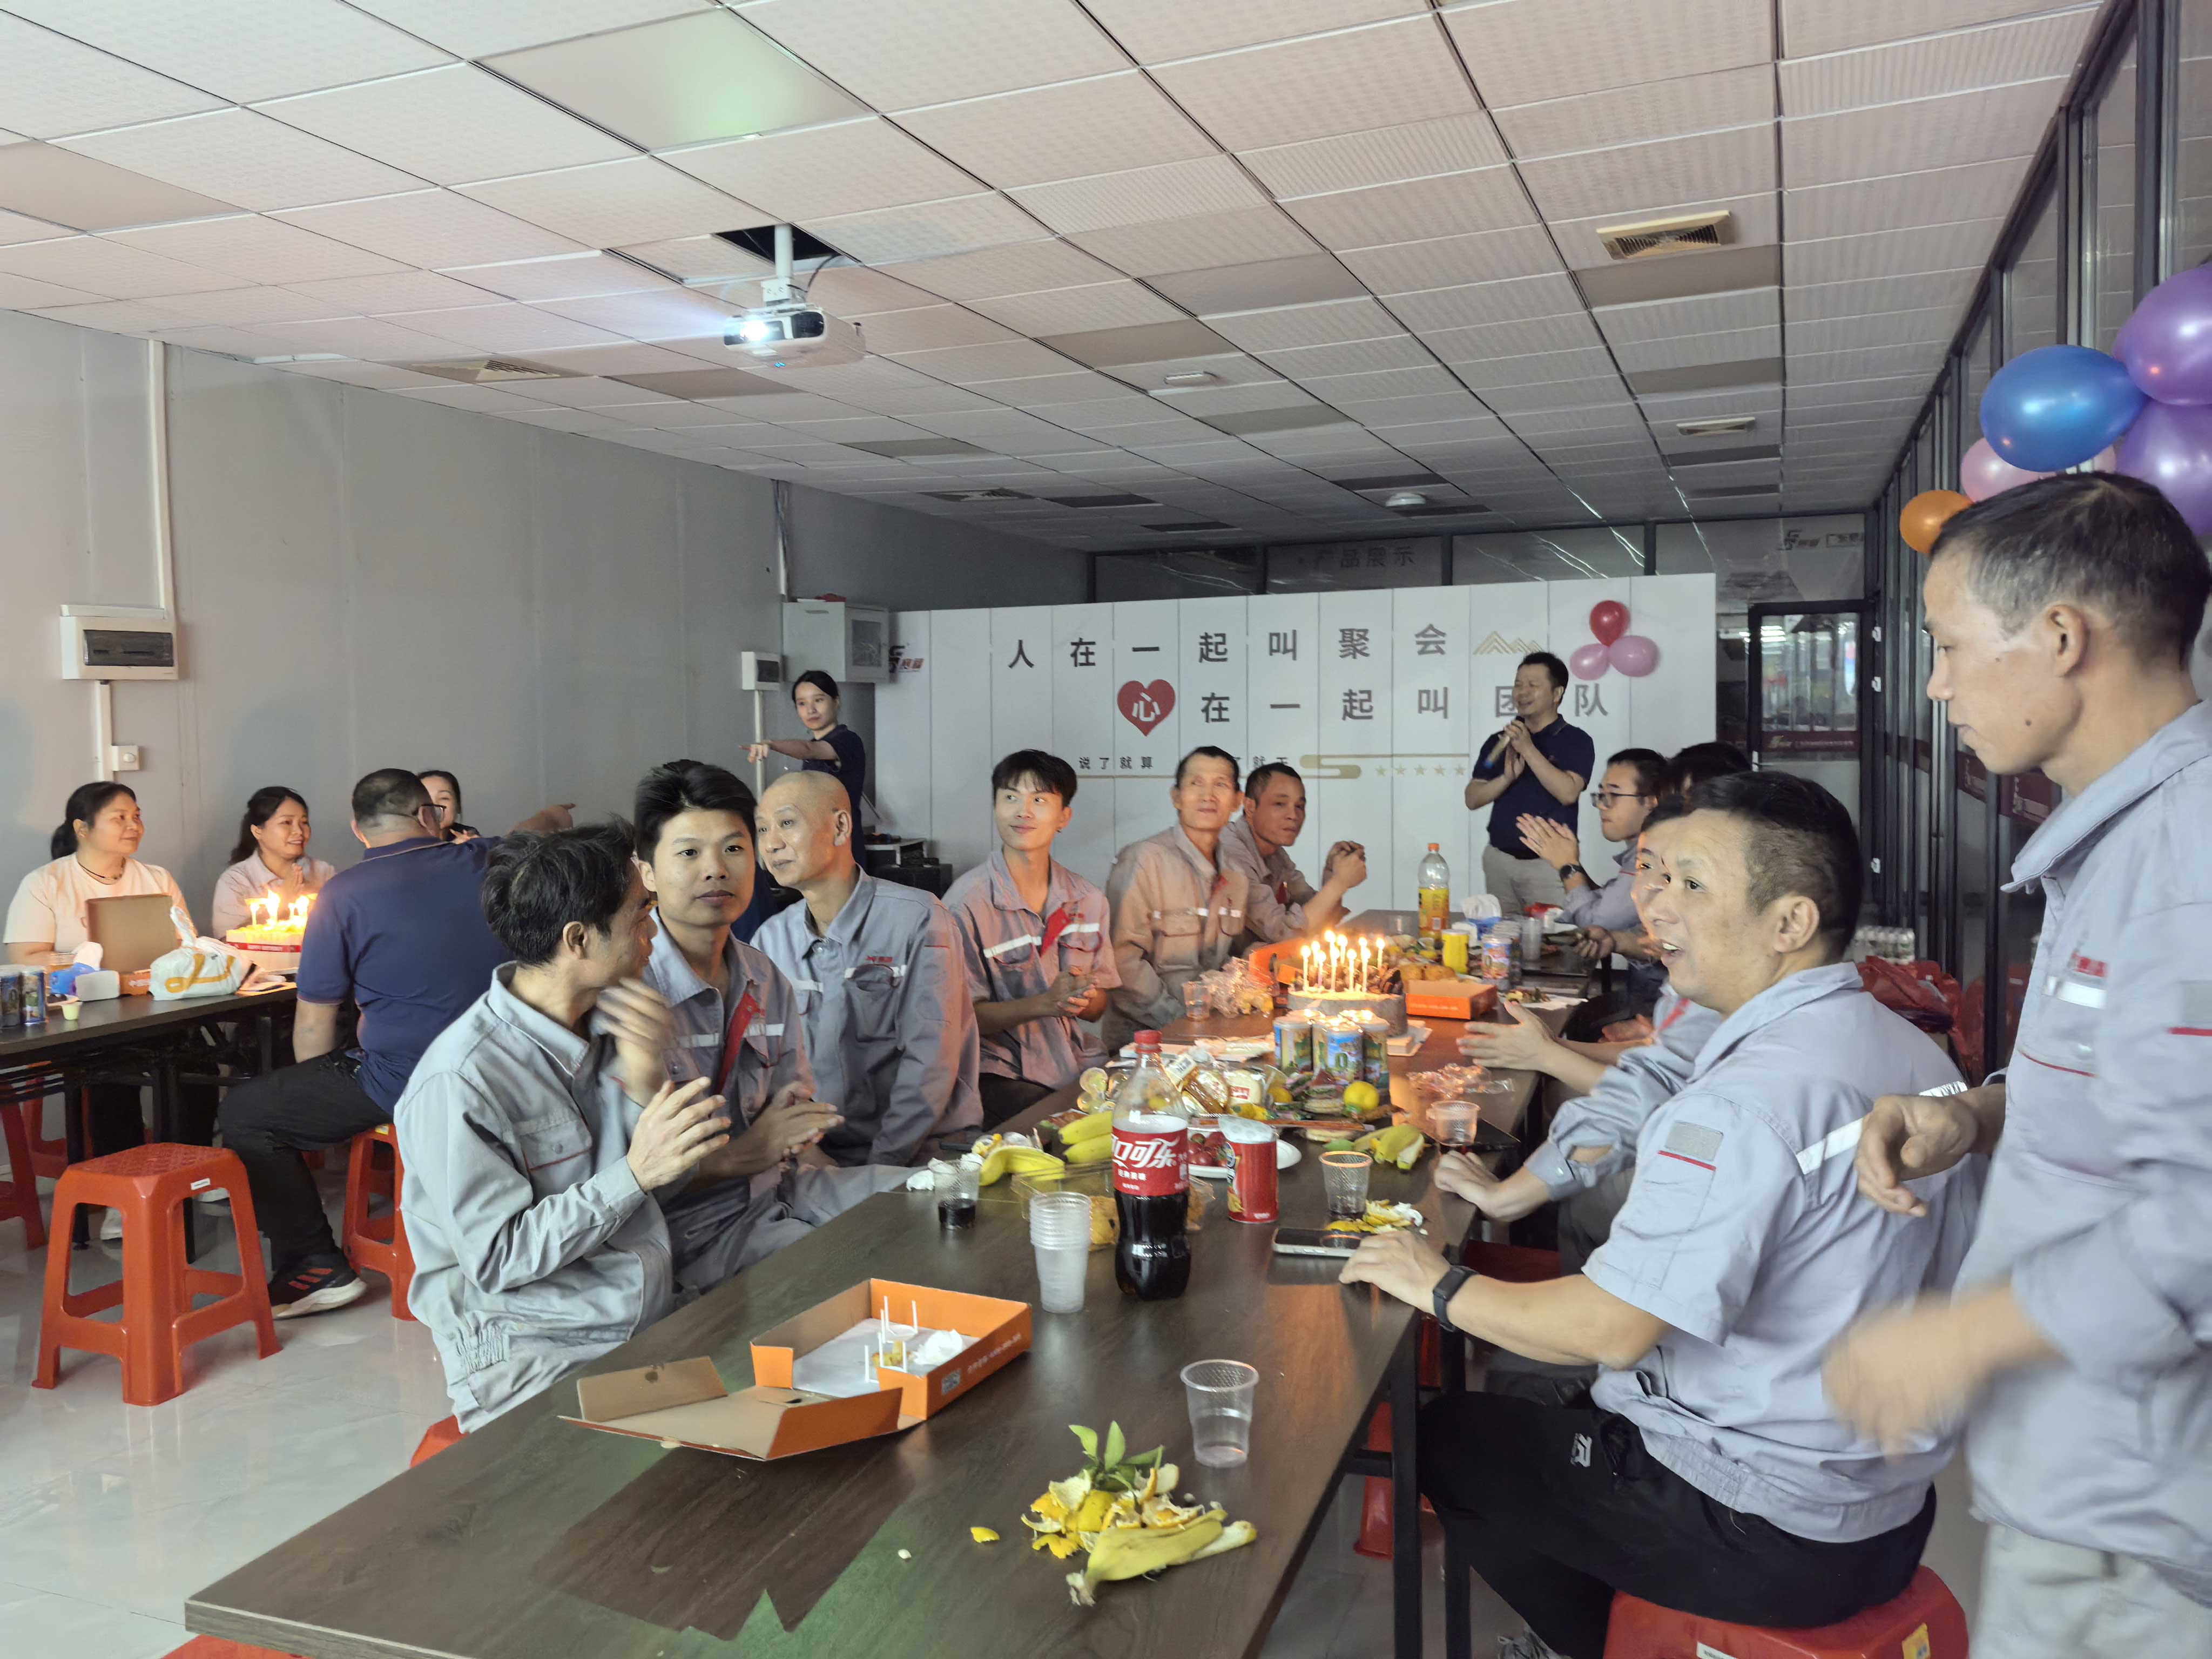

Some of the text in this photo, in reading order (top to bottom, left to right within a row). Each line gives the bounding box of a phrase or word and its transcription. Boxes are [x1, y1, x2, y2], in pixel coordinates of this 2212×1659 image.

[1008, 624, 1447, 669] 人在一起叫聚会
